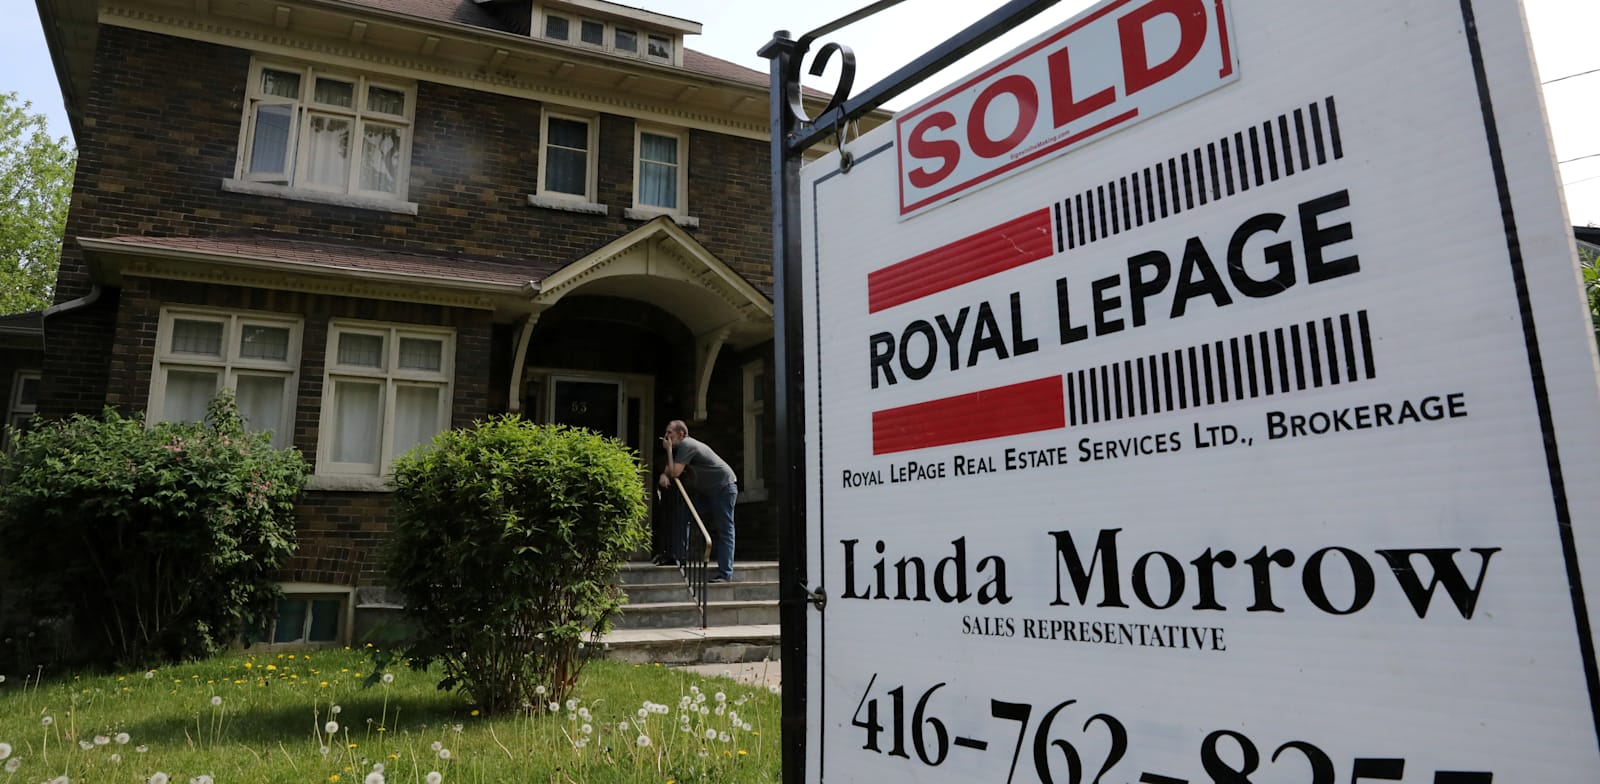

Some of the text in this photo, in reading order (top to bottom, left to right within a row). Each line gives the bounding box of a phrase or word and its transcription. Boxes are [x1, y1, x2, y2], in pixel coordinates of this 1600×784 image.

[907, 0, 1207, 188] SOLD
[869, 291, 1039, 389] ROYAL
[840, 527, 1502, 621] Linda Morrow
[962, 615, 1226, 652] SALES REPRESENTATIVE
[851, 673, 1494, 784] 416-762-8
